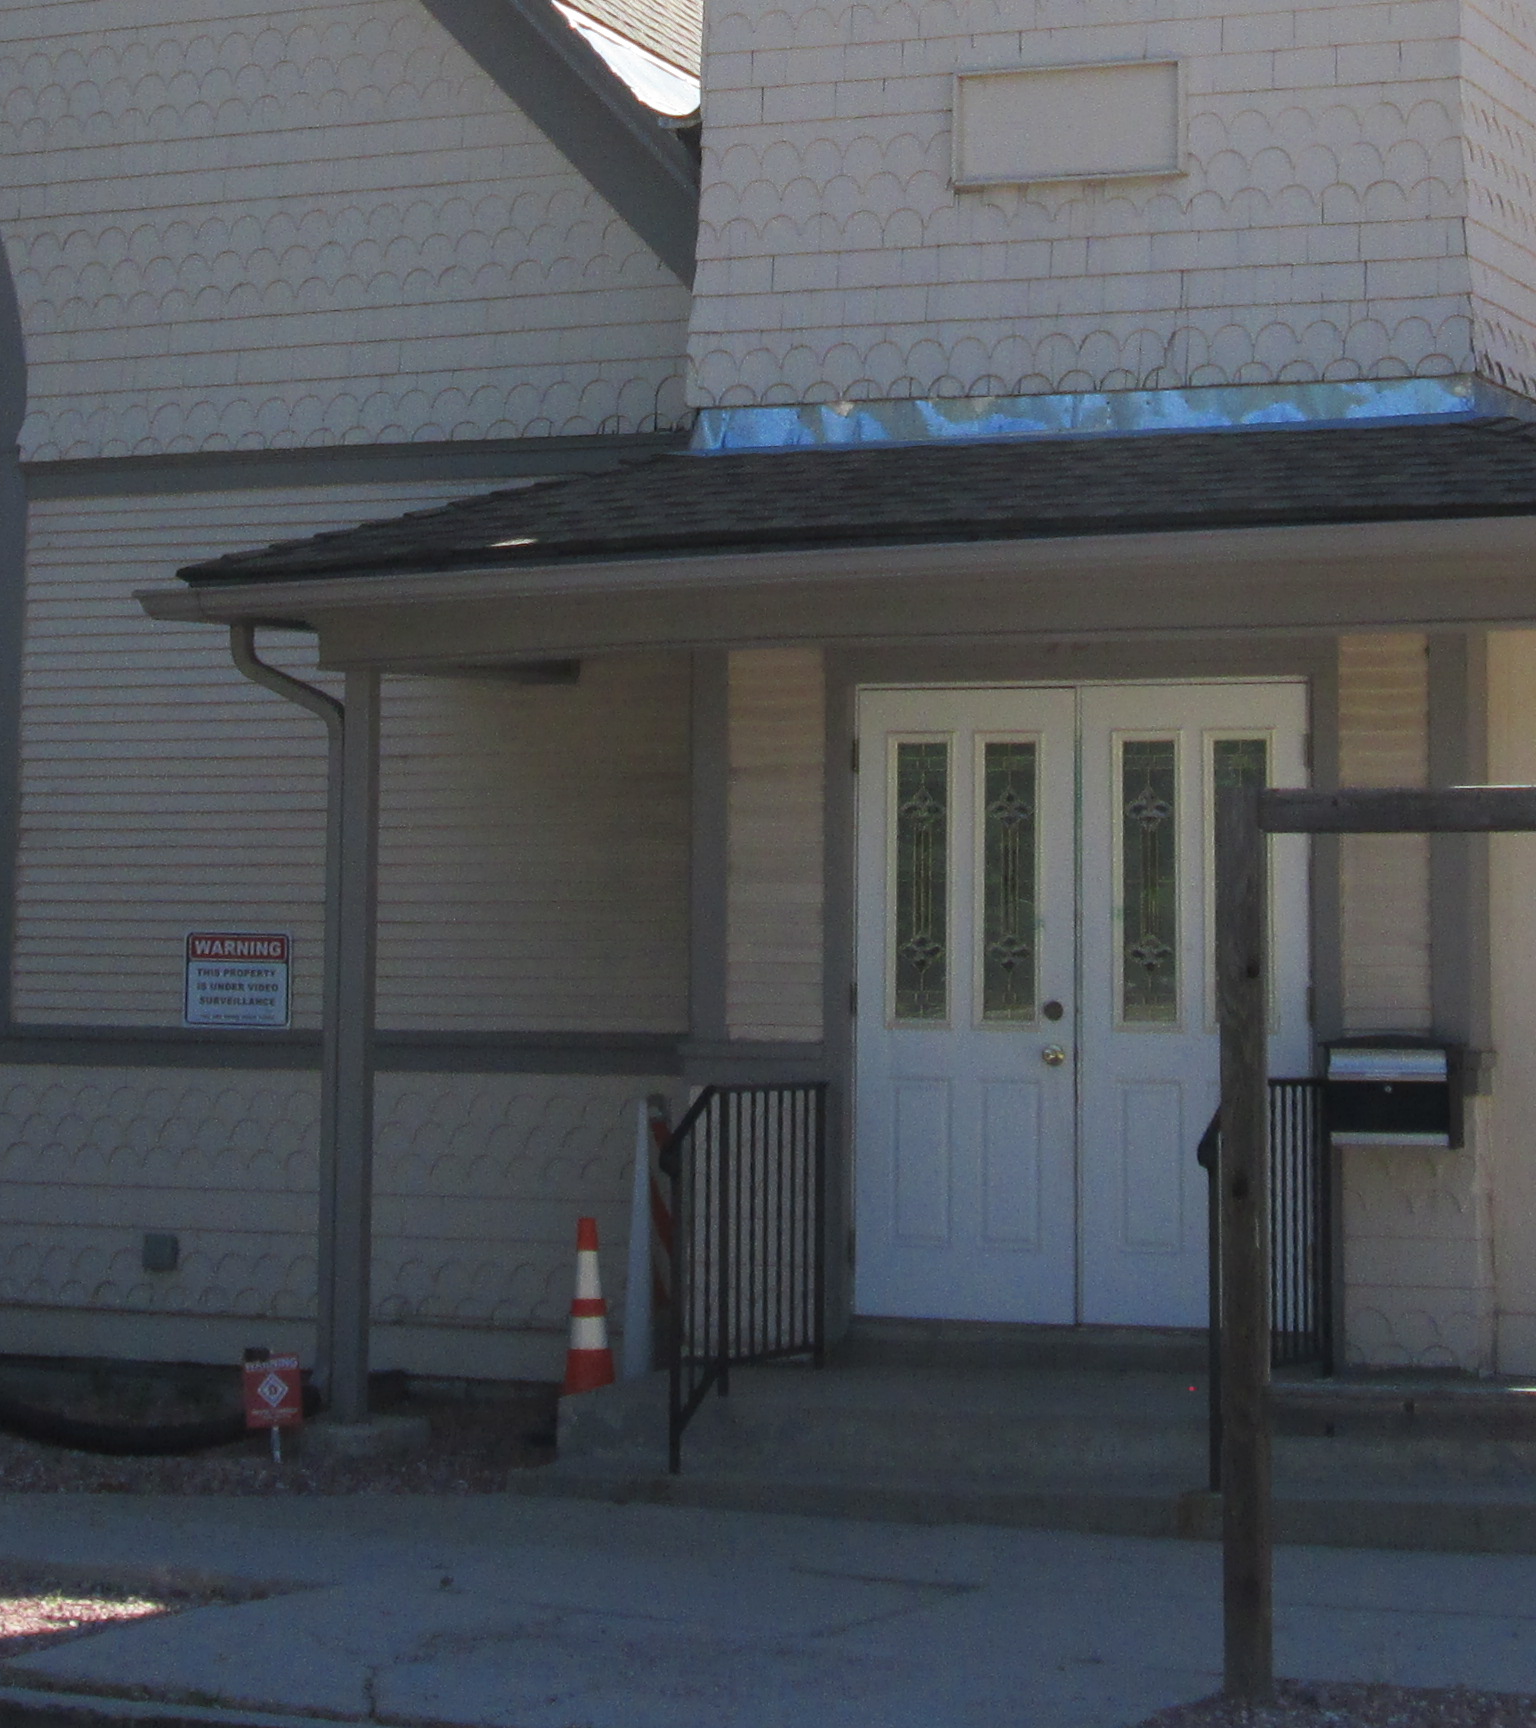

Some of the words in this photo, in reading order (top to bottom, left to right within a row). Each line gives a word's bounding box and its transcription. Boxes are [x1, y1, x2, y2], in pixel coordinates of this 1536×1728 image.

[195, 940, 282, 956] WARNING
[197, 968, 220, 977] THIS
[223, 968, 276, 978] PROPERTY
[196, 982, 207, 991] IS
[210, 982, 245, 991] UNDER
[248, 983, 279, 992] VIDEO
[199, 996, 276, 1006] SURVEILLANCE
